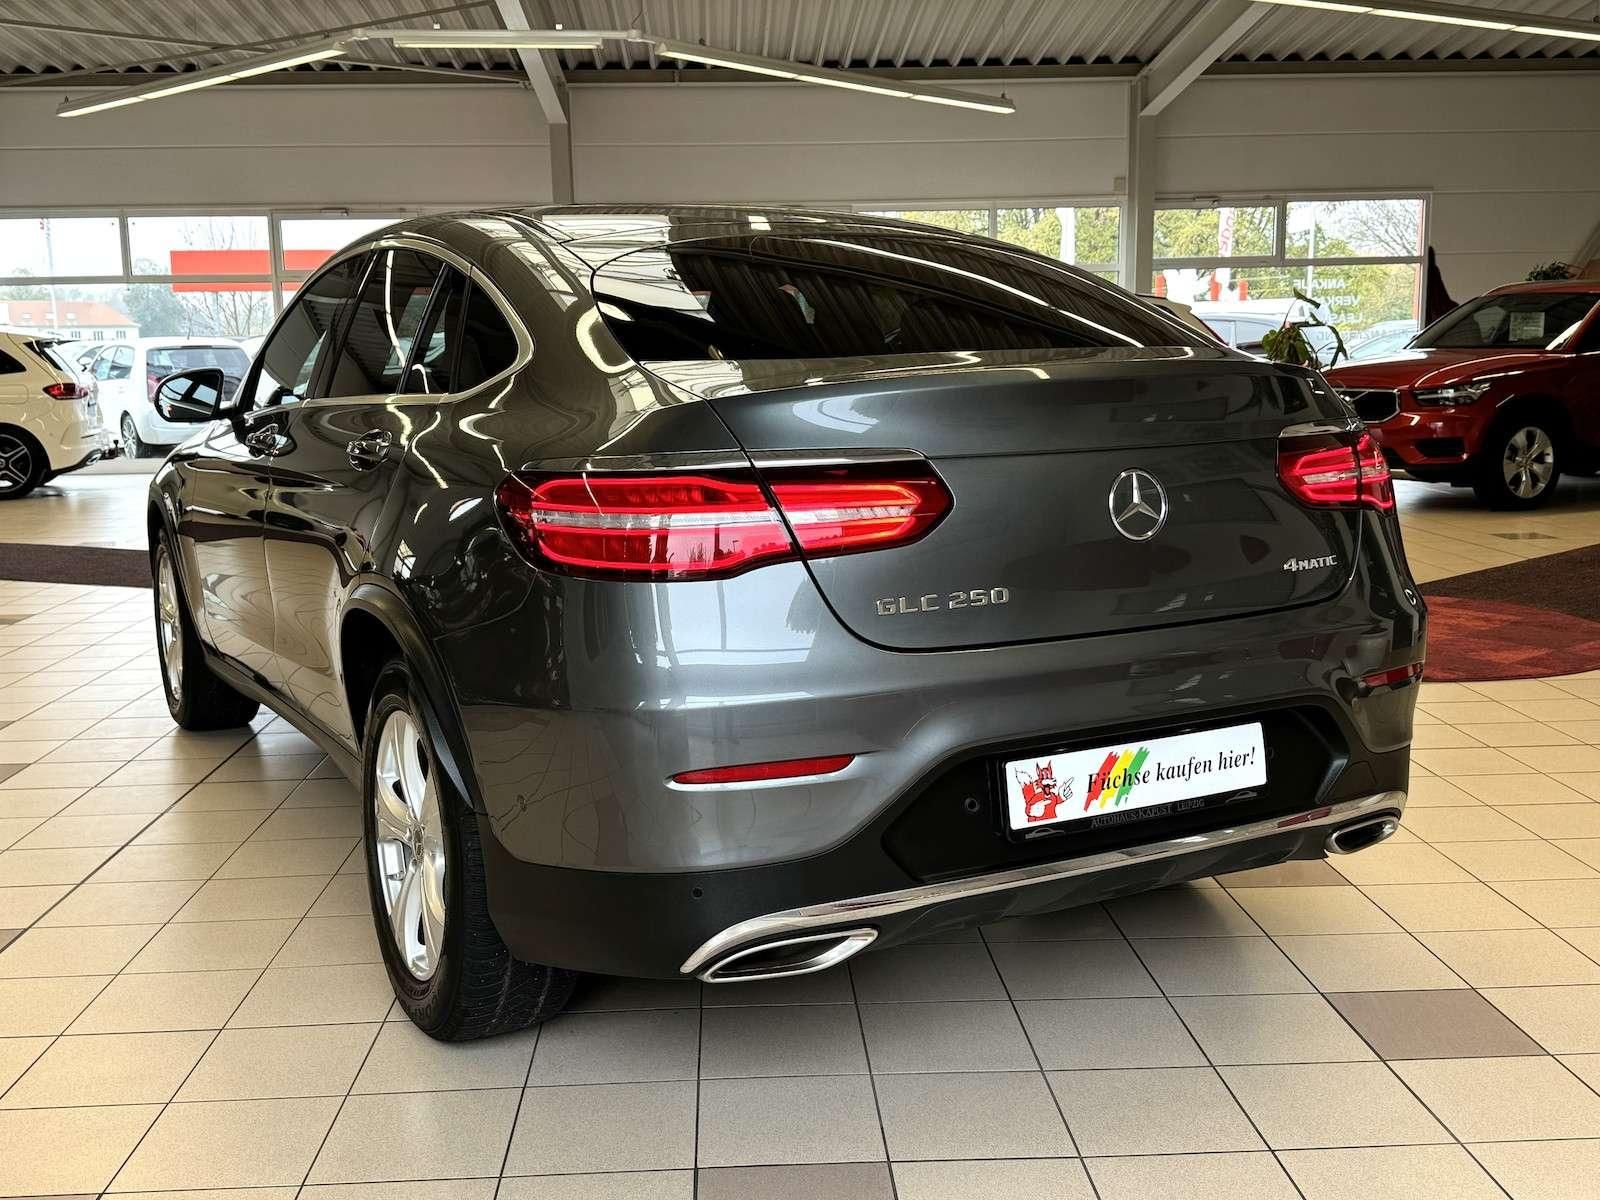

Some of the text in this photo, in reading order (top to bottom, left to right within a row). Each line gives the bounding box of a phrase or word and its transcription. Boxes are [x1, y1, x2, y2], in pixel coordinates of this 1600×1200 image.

[1283, 554, 1338, 571] 4MATIC
[876, 587, 1010, 616] GLC 250
[1086, 746, 1256, 794] Füchse kaufen hier!
